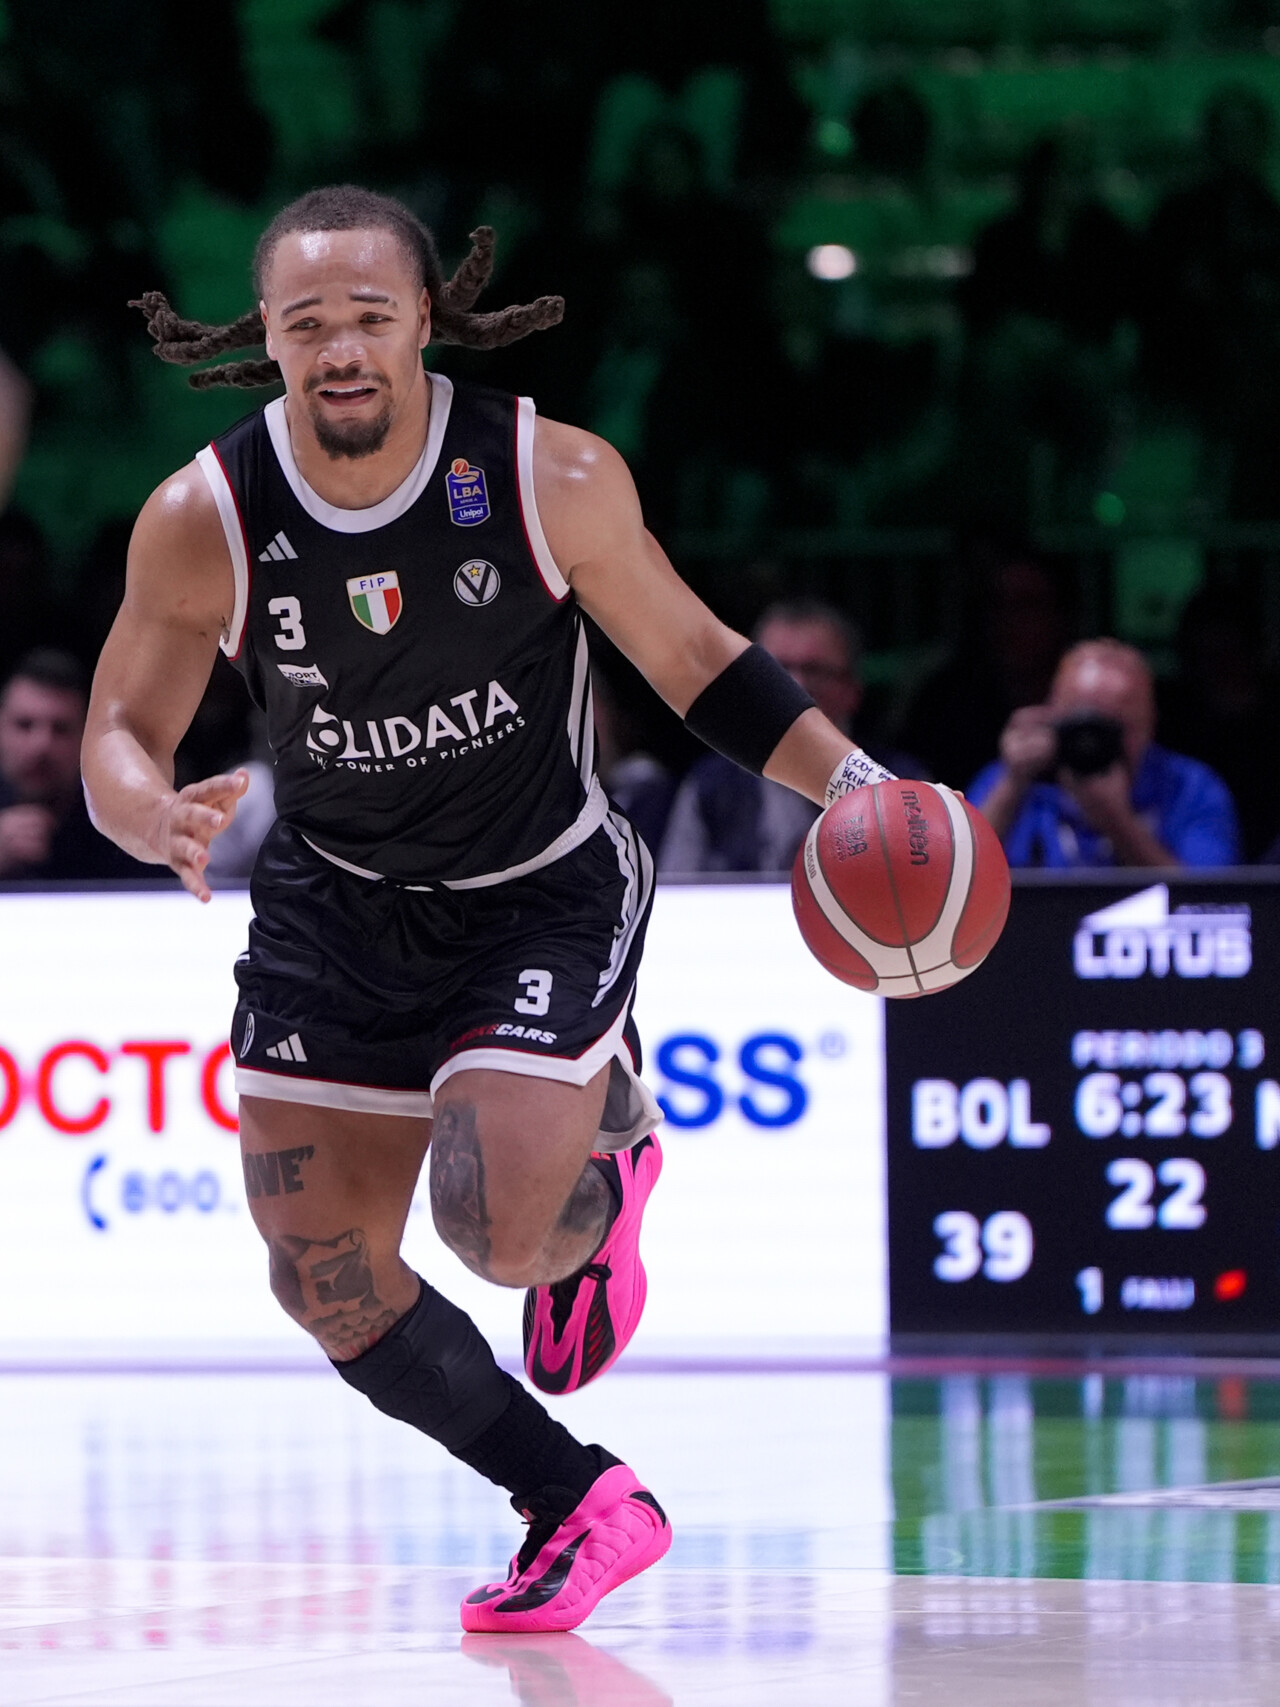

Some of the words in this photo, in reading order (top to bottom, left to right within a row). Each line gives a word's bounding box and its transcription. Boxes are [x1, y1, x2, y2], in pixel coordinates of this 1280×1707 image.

[453, 485, 483, 499] LBA
[460, 507, 484, 518] Unipol
[359, 576, 386, 591] FIP
[268, 596, 307, 651] 3
[406, 756, 428, 768] OF
[439, 715, 526, 760] PIONEERS
[901, 790, 931, 866] molten
[1074, 927, 1253, 979] LOTUS
[514, 968, 553, 1016] 3
[911, 1078, 1052, 1150] BOL
[1076, 1072, 1233, 1139] 6:23
[1105, 1158, 1208, 1230] 22
[933, 1210, 1034, 1283] 39
